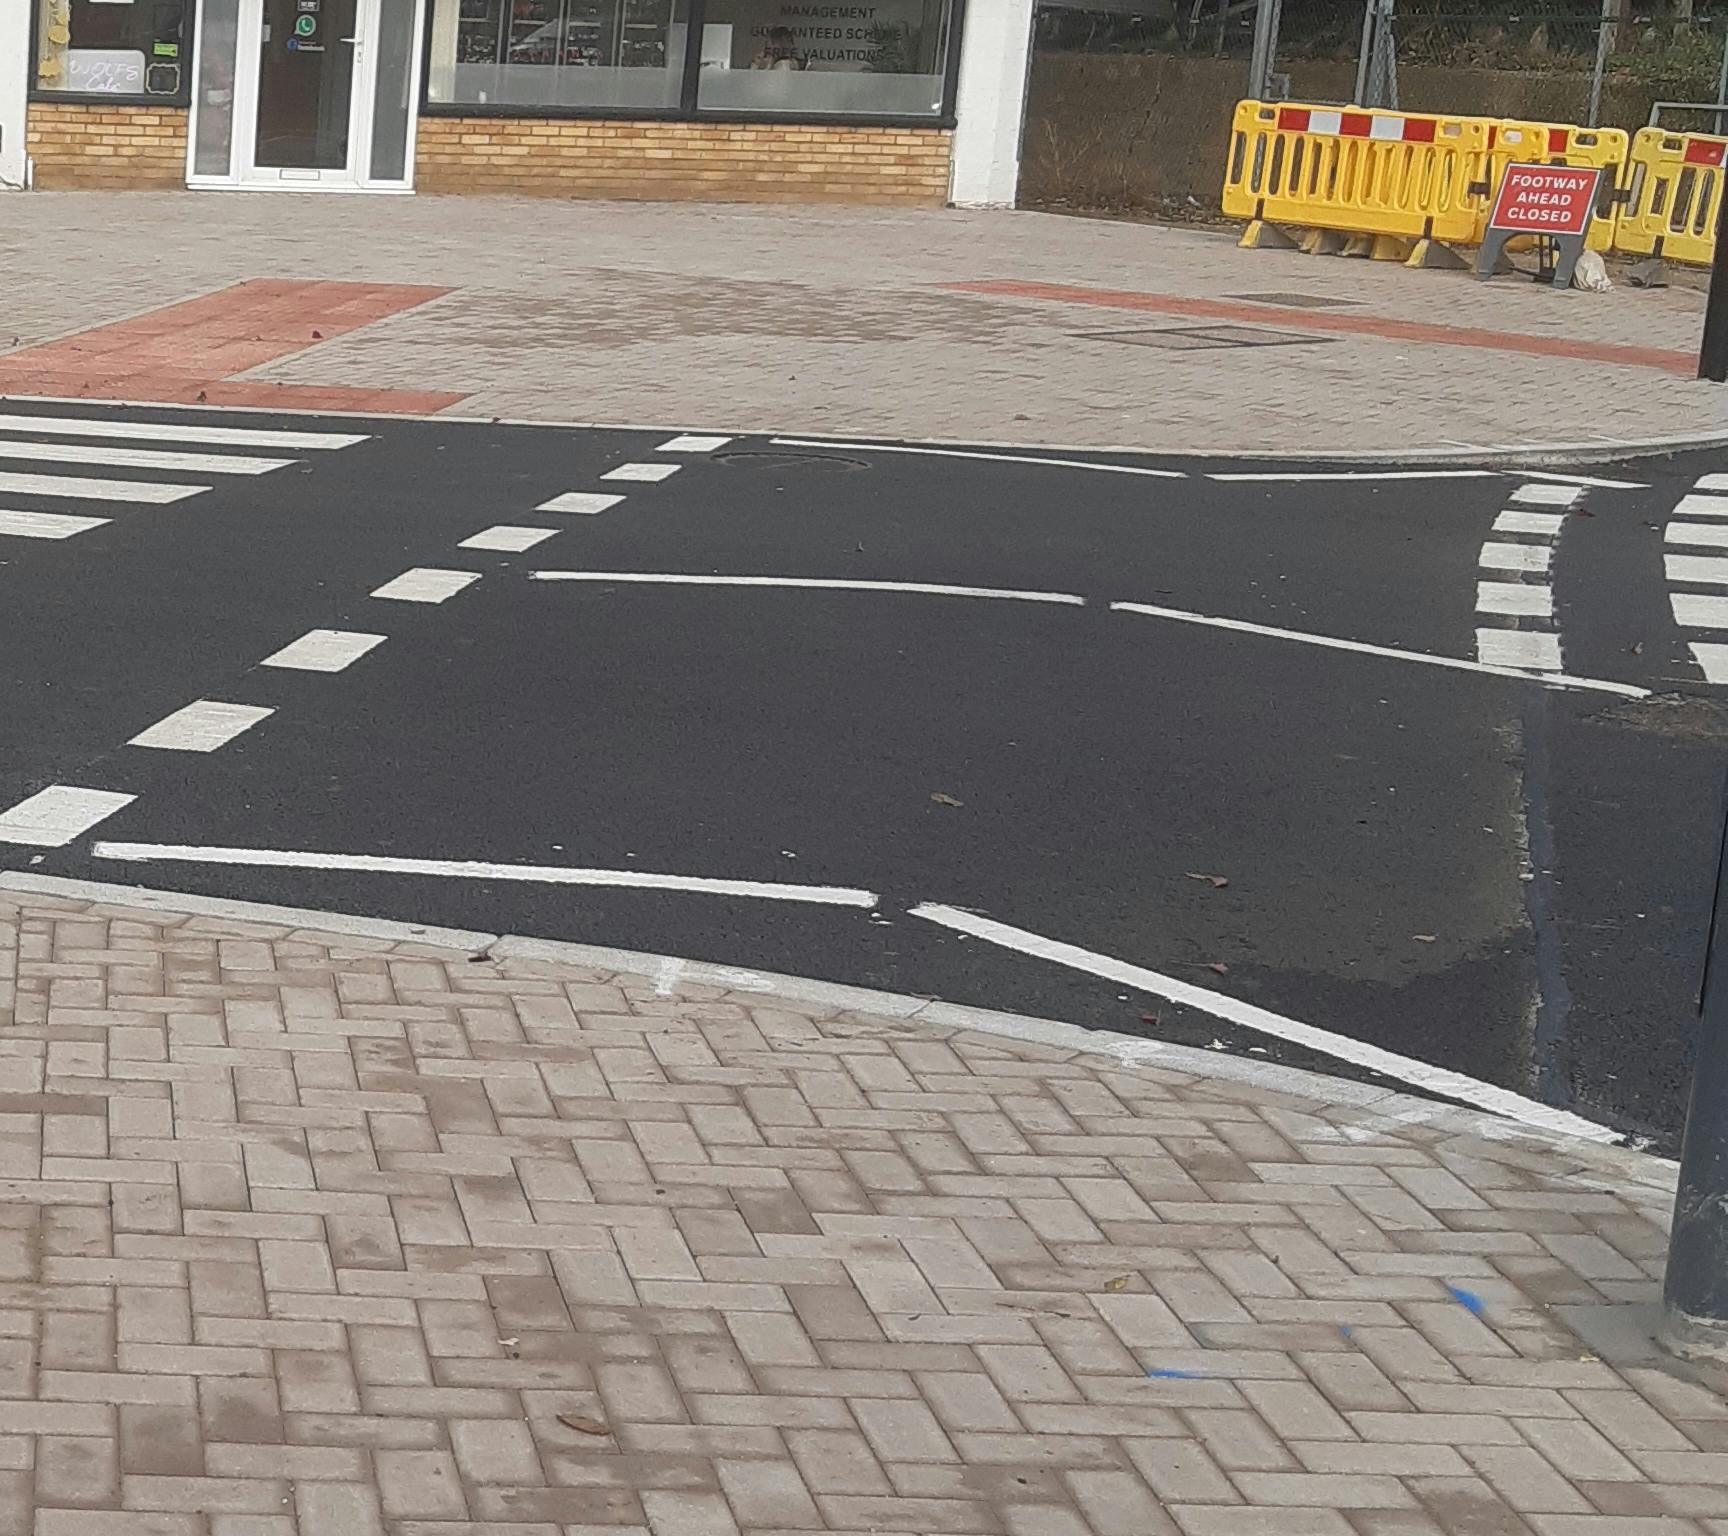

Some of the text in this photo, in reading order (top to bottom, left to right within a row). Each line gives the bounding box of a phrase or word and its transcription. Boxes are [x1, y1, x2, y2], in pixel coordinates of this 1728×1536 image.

[780, 8, 876, 19] MANAGEMENT
[752, 26, 842, 40] GUANTEED
[763, 47, 795, 60] FREE
[1511, 175, 1588, 190] FOOTWAY
[1516, 192, 1572, 205] AHEAD
[1507, 208, 1572, 222] CLOSED
